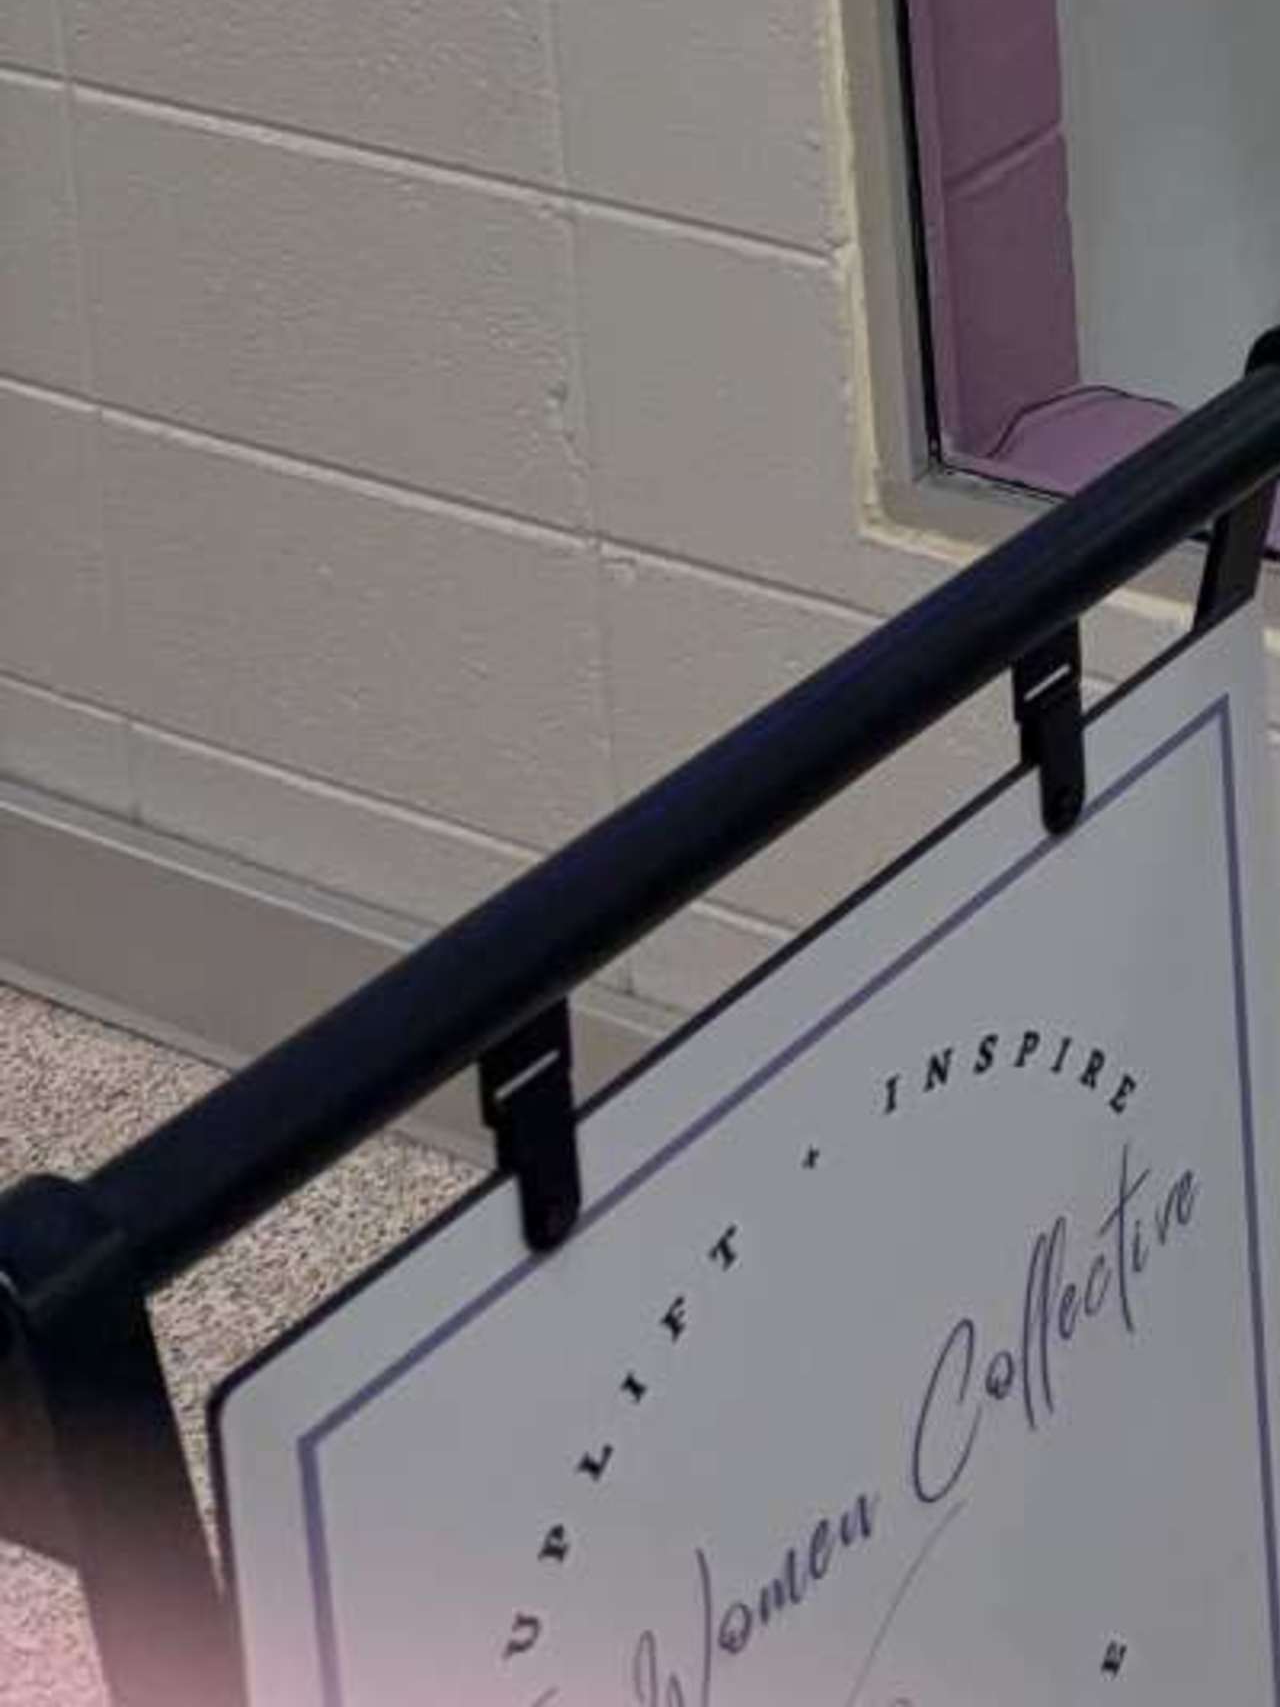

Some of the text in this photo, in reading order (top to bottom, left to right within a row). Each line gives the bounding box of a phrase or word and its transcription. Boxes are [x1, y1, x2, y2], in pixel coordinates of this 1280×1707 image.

[503, 1224, 742, 1660] UPLIFT
[881, 1031, 1138, 1115] INSPIRE
[634, 1141, 1202, 1707] Women Collective
